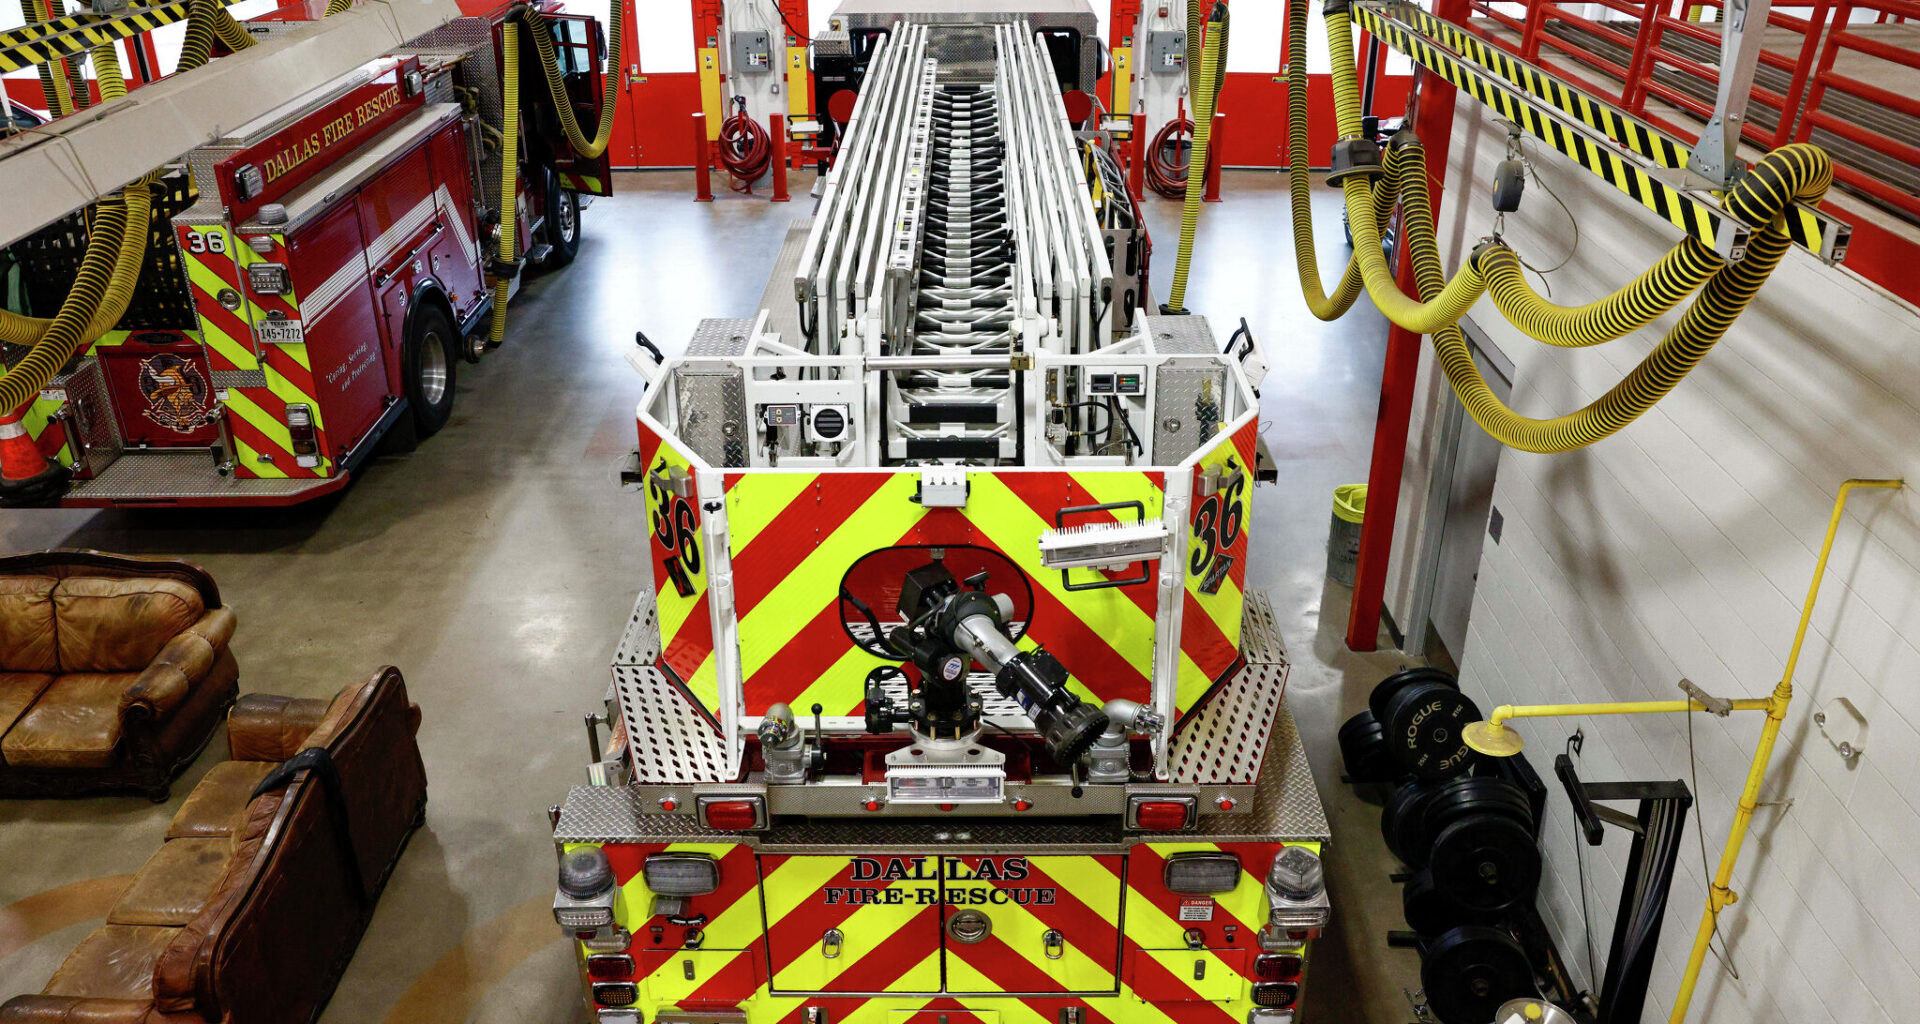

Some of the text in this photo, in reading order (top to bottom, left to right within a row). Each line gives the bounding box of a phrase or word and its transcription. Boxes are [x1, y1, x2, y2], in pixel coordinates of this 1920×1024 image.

[264, 85, 400, 184] DALLAS FIRE RESCUE
[187, 231, 226, 253] 36
[650, 474, 700, 576] 36
[1190, 470, 1245, 577] 36
[1407, 700, 1442, 749] ROGUE
[850, 857, 1030, 881] DALLAS
[824, 887, 1056, 905] FIRE-RESCUE
